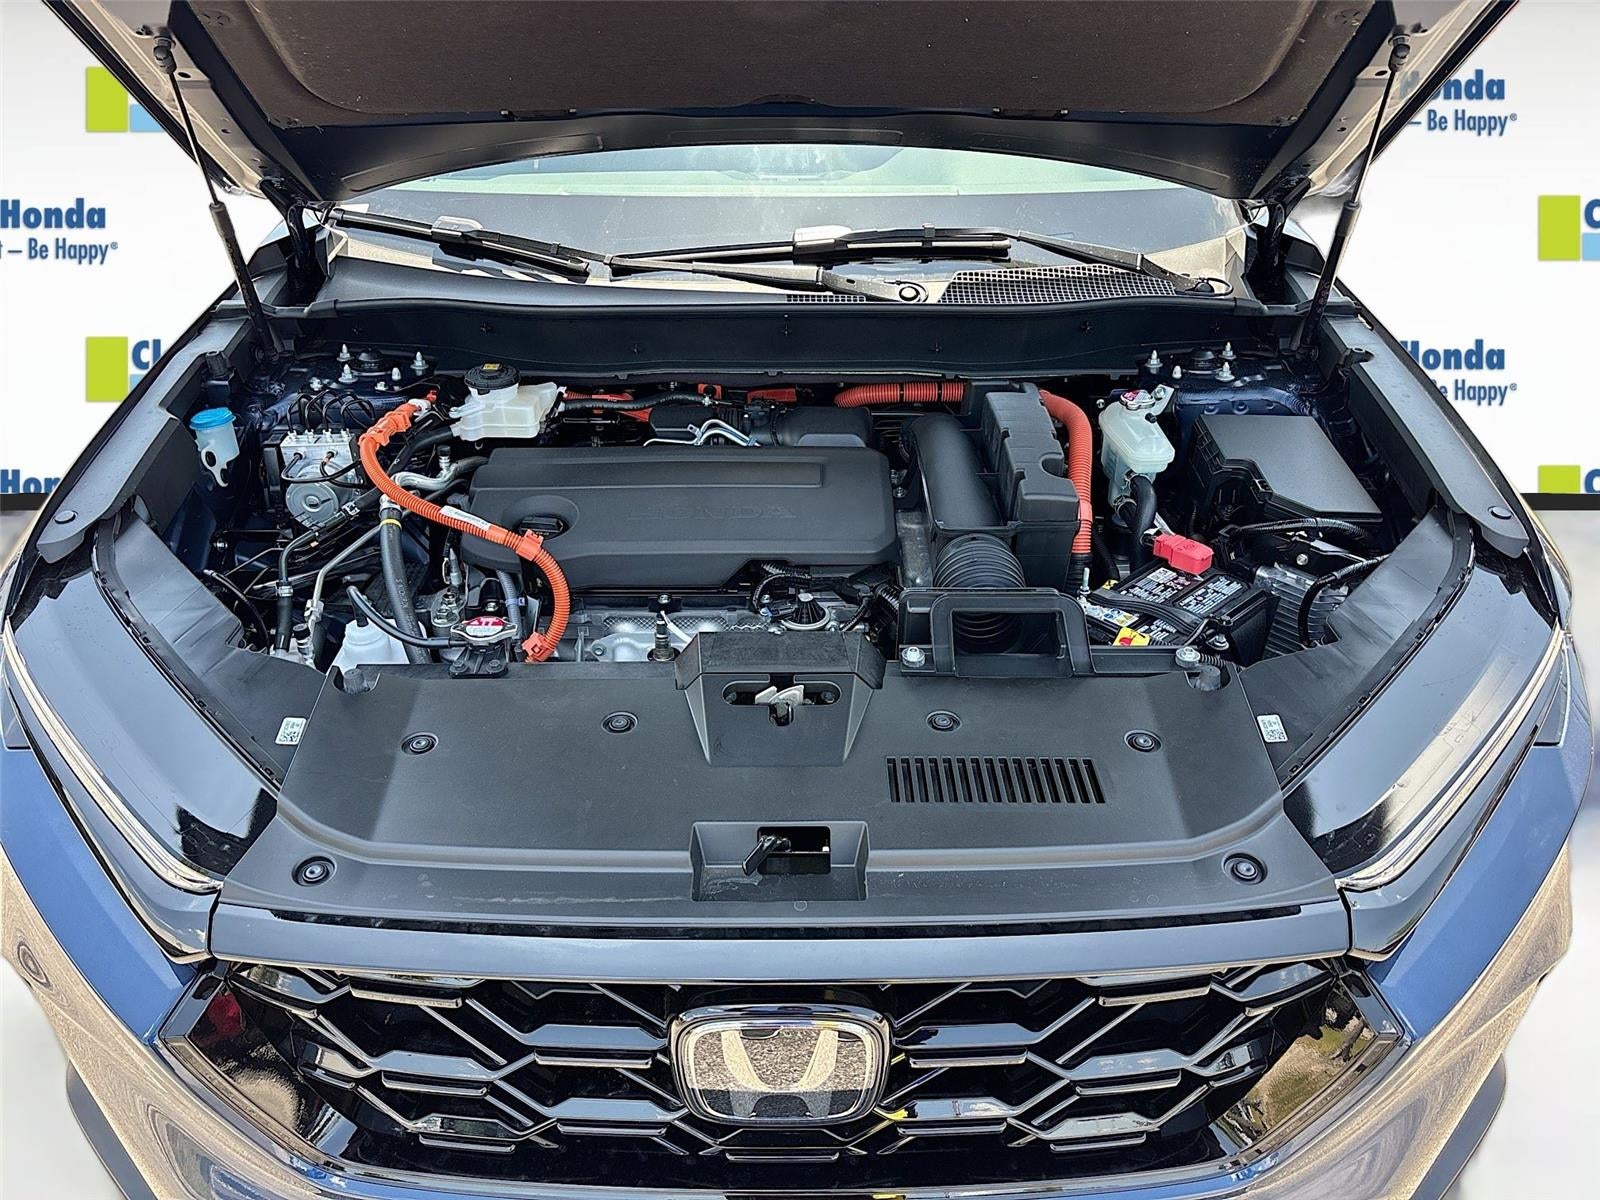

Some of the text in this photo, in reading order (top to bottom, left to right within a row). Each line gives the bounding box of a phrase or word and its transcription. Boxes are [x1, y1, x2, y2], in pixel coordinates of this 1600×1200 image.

[1427, 109, 1448, 131] Be
[0, 198, 106, 229] Honda
[28, 237, 49, 260] Be
